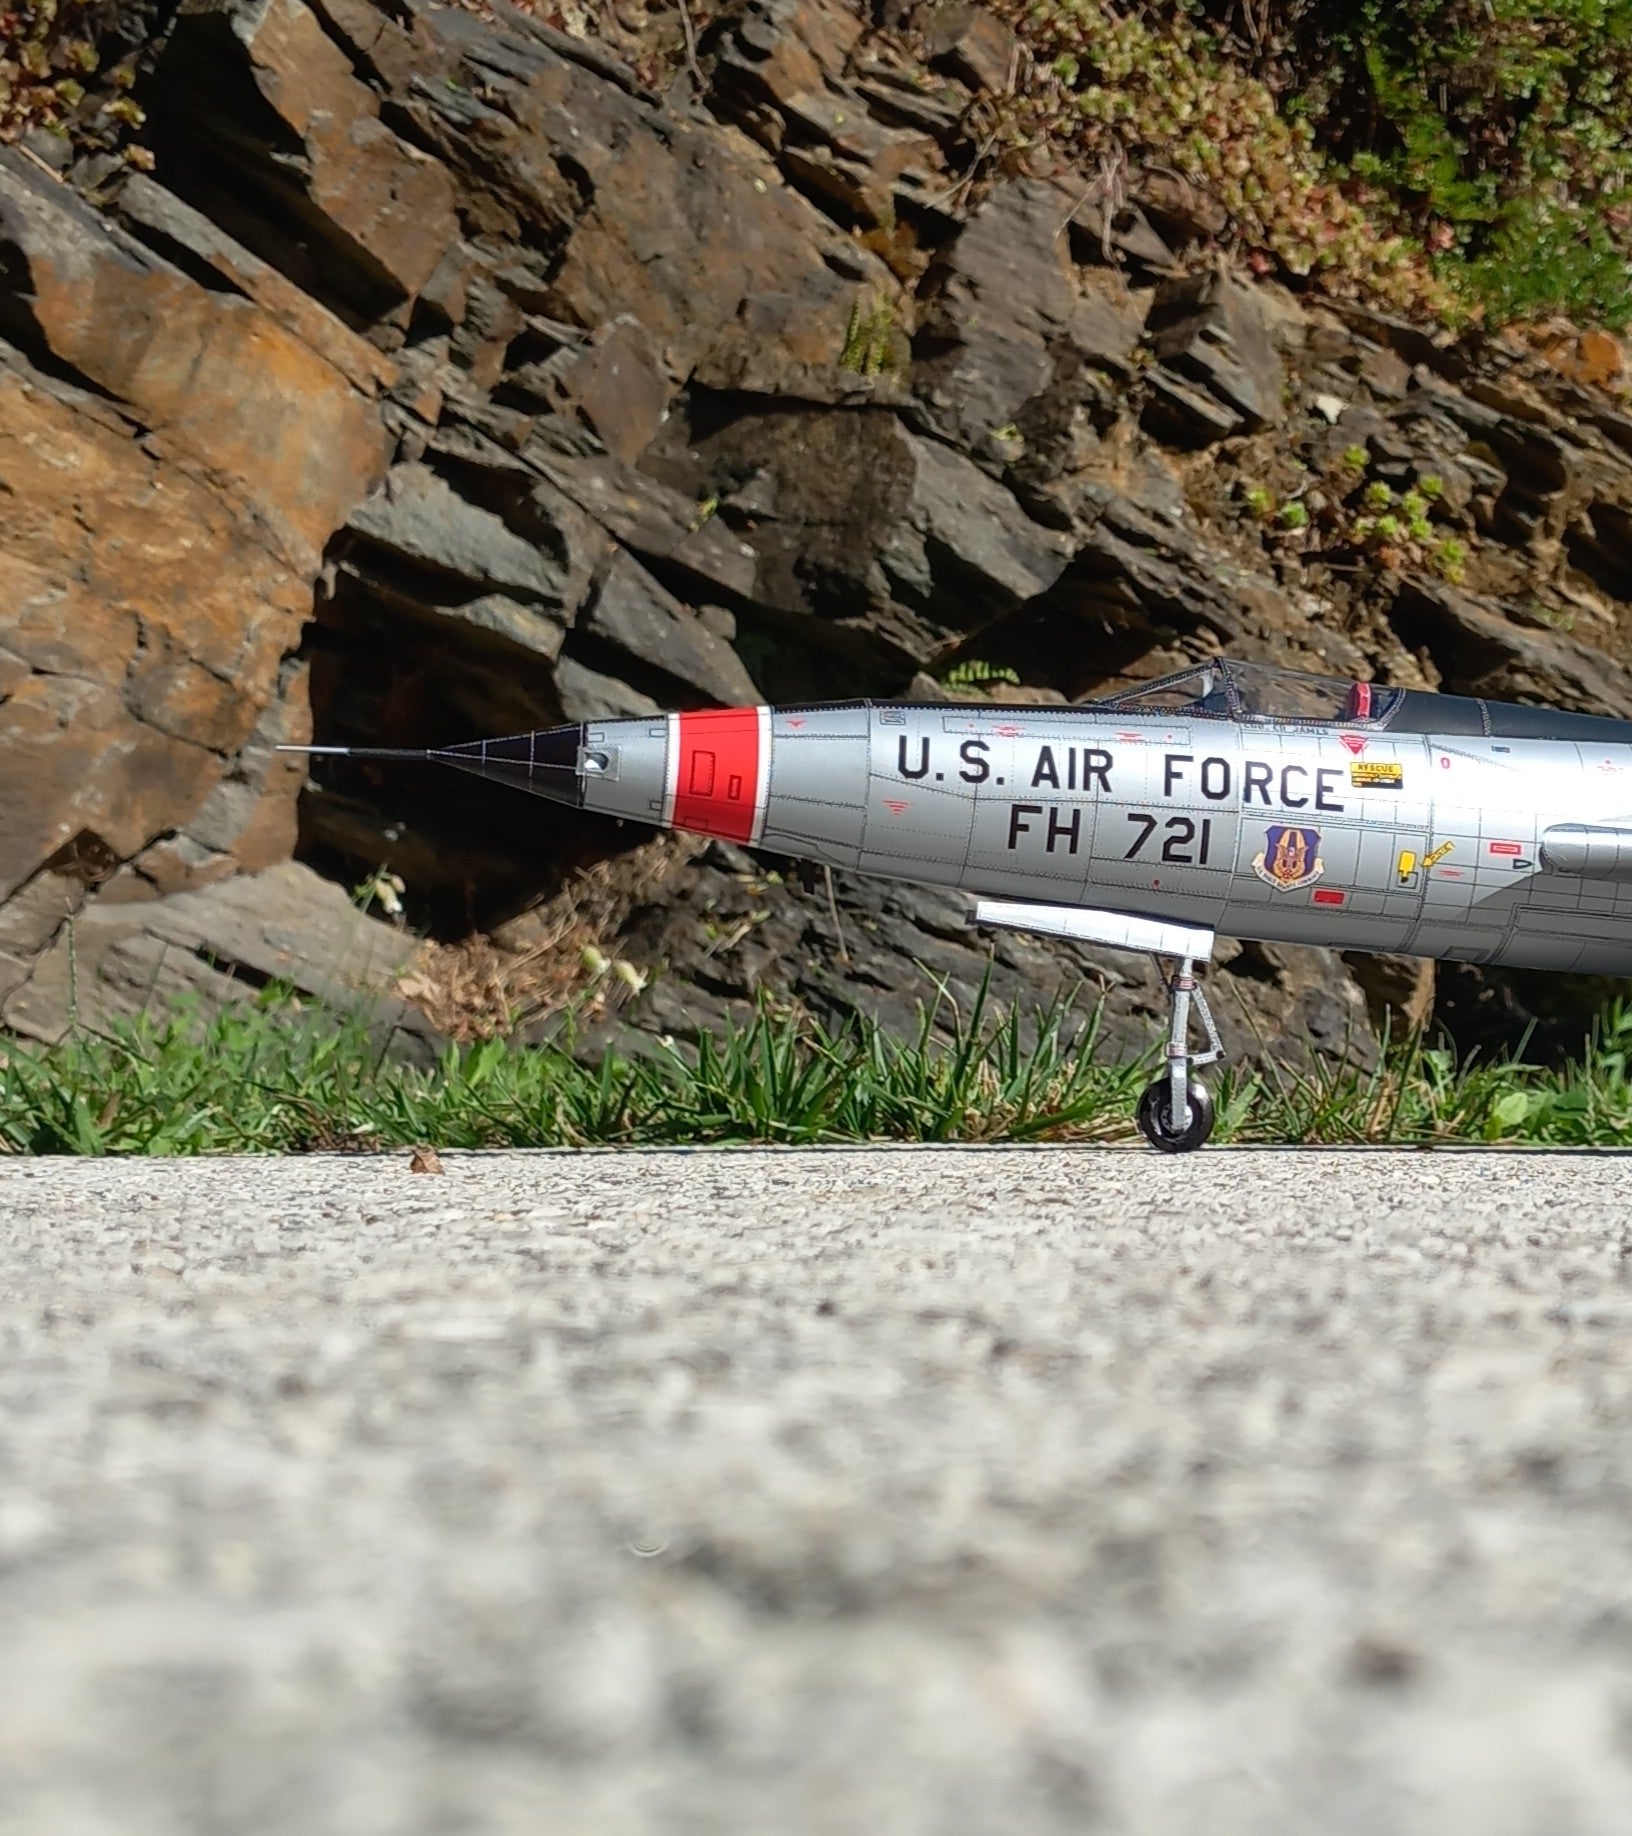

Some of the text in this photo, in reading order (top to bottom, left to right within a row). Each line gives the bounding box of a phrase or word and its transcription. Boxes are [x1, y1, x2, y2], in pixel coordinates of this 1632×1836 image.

[897, 735, 1345, 813] U.S. AIR FORCE
[1357, 764, 1394, 773] RESCUE
[1008, 803, 1212, 865] FH 721
